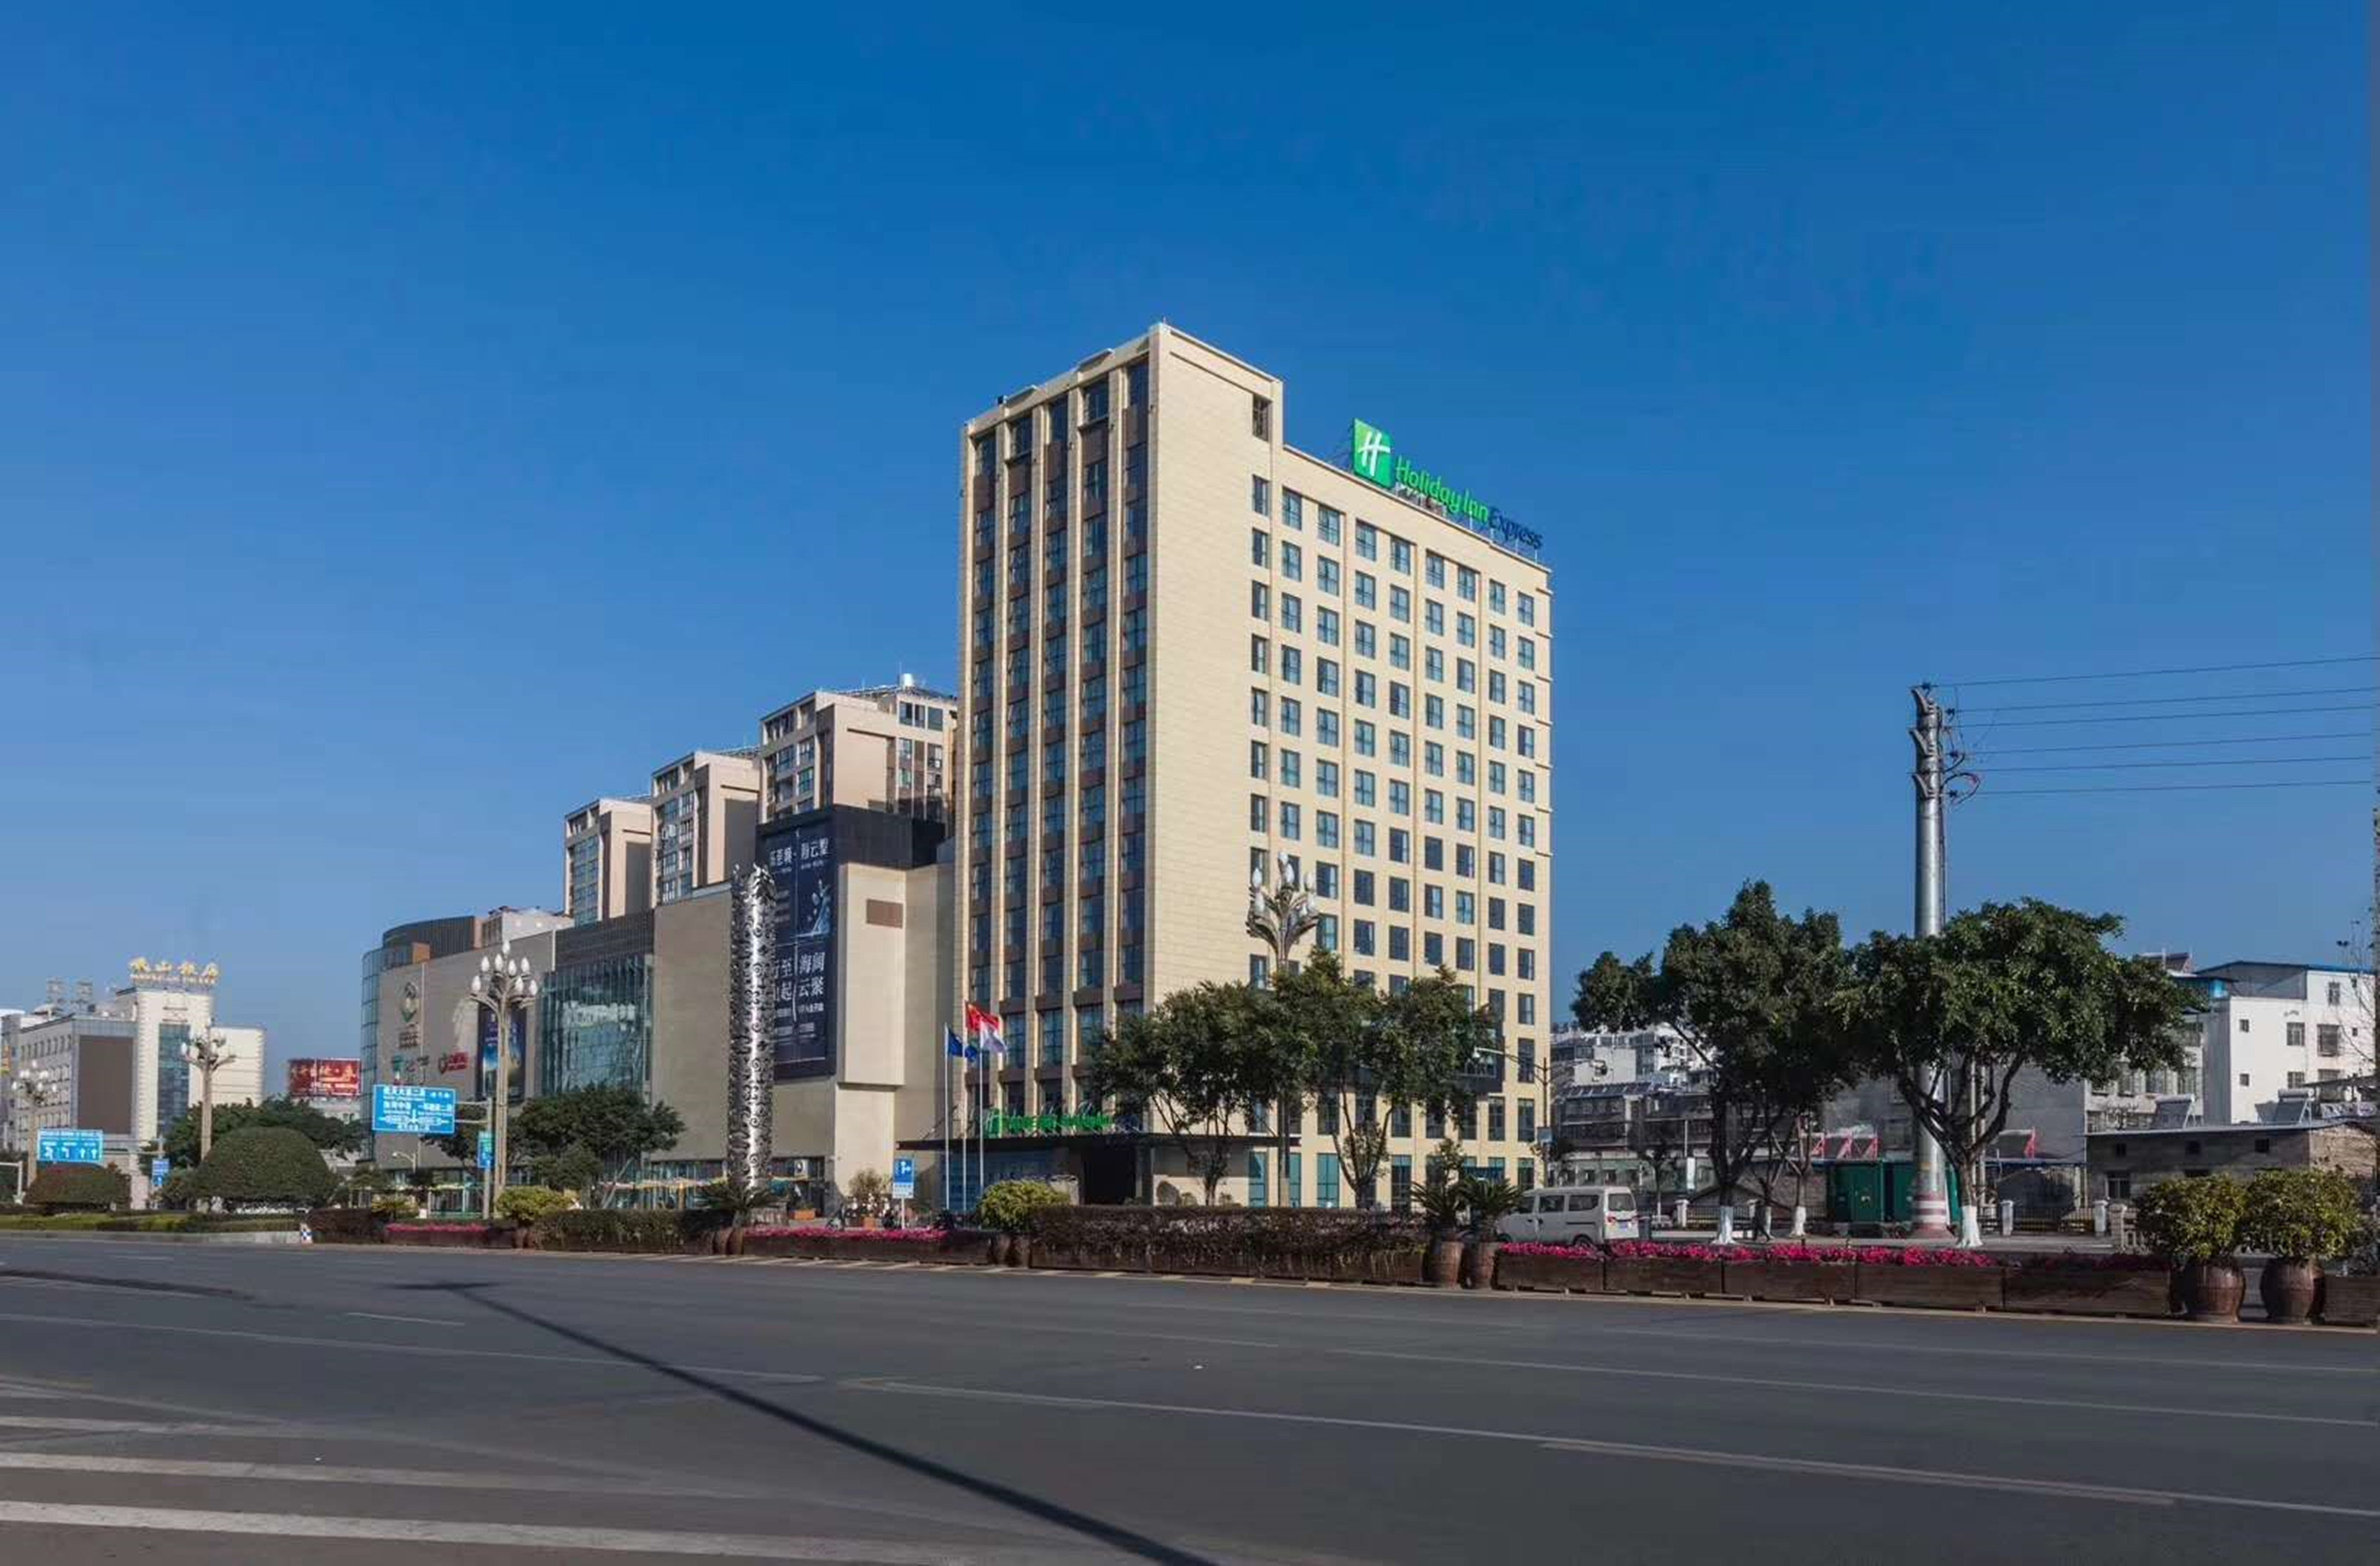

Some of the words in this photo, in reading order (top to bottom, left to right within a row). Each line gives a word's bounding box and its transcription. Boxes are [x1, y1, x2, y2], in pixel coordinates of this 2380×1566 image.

[1396, 455, 1461, 513] Holiday
[1463, 488, 1488, 523] Inn
[1489, 507, 1543, 550] Express
